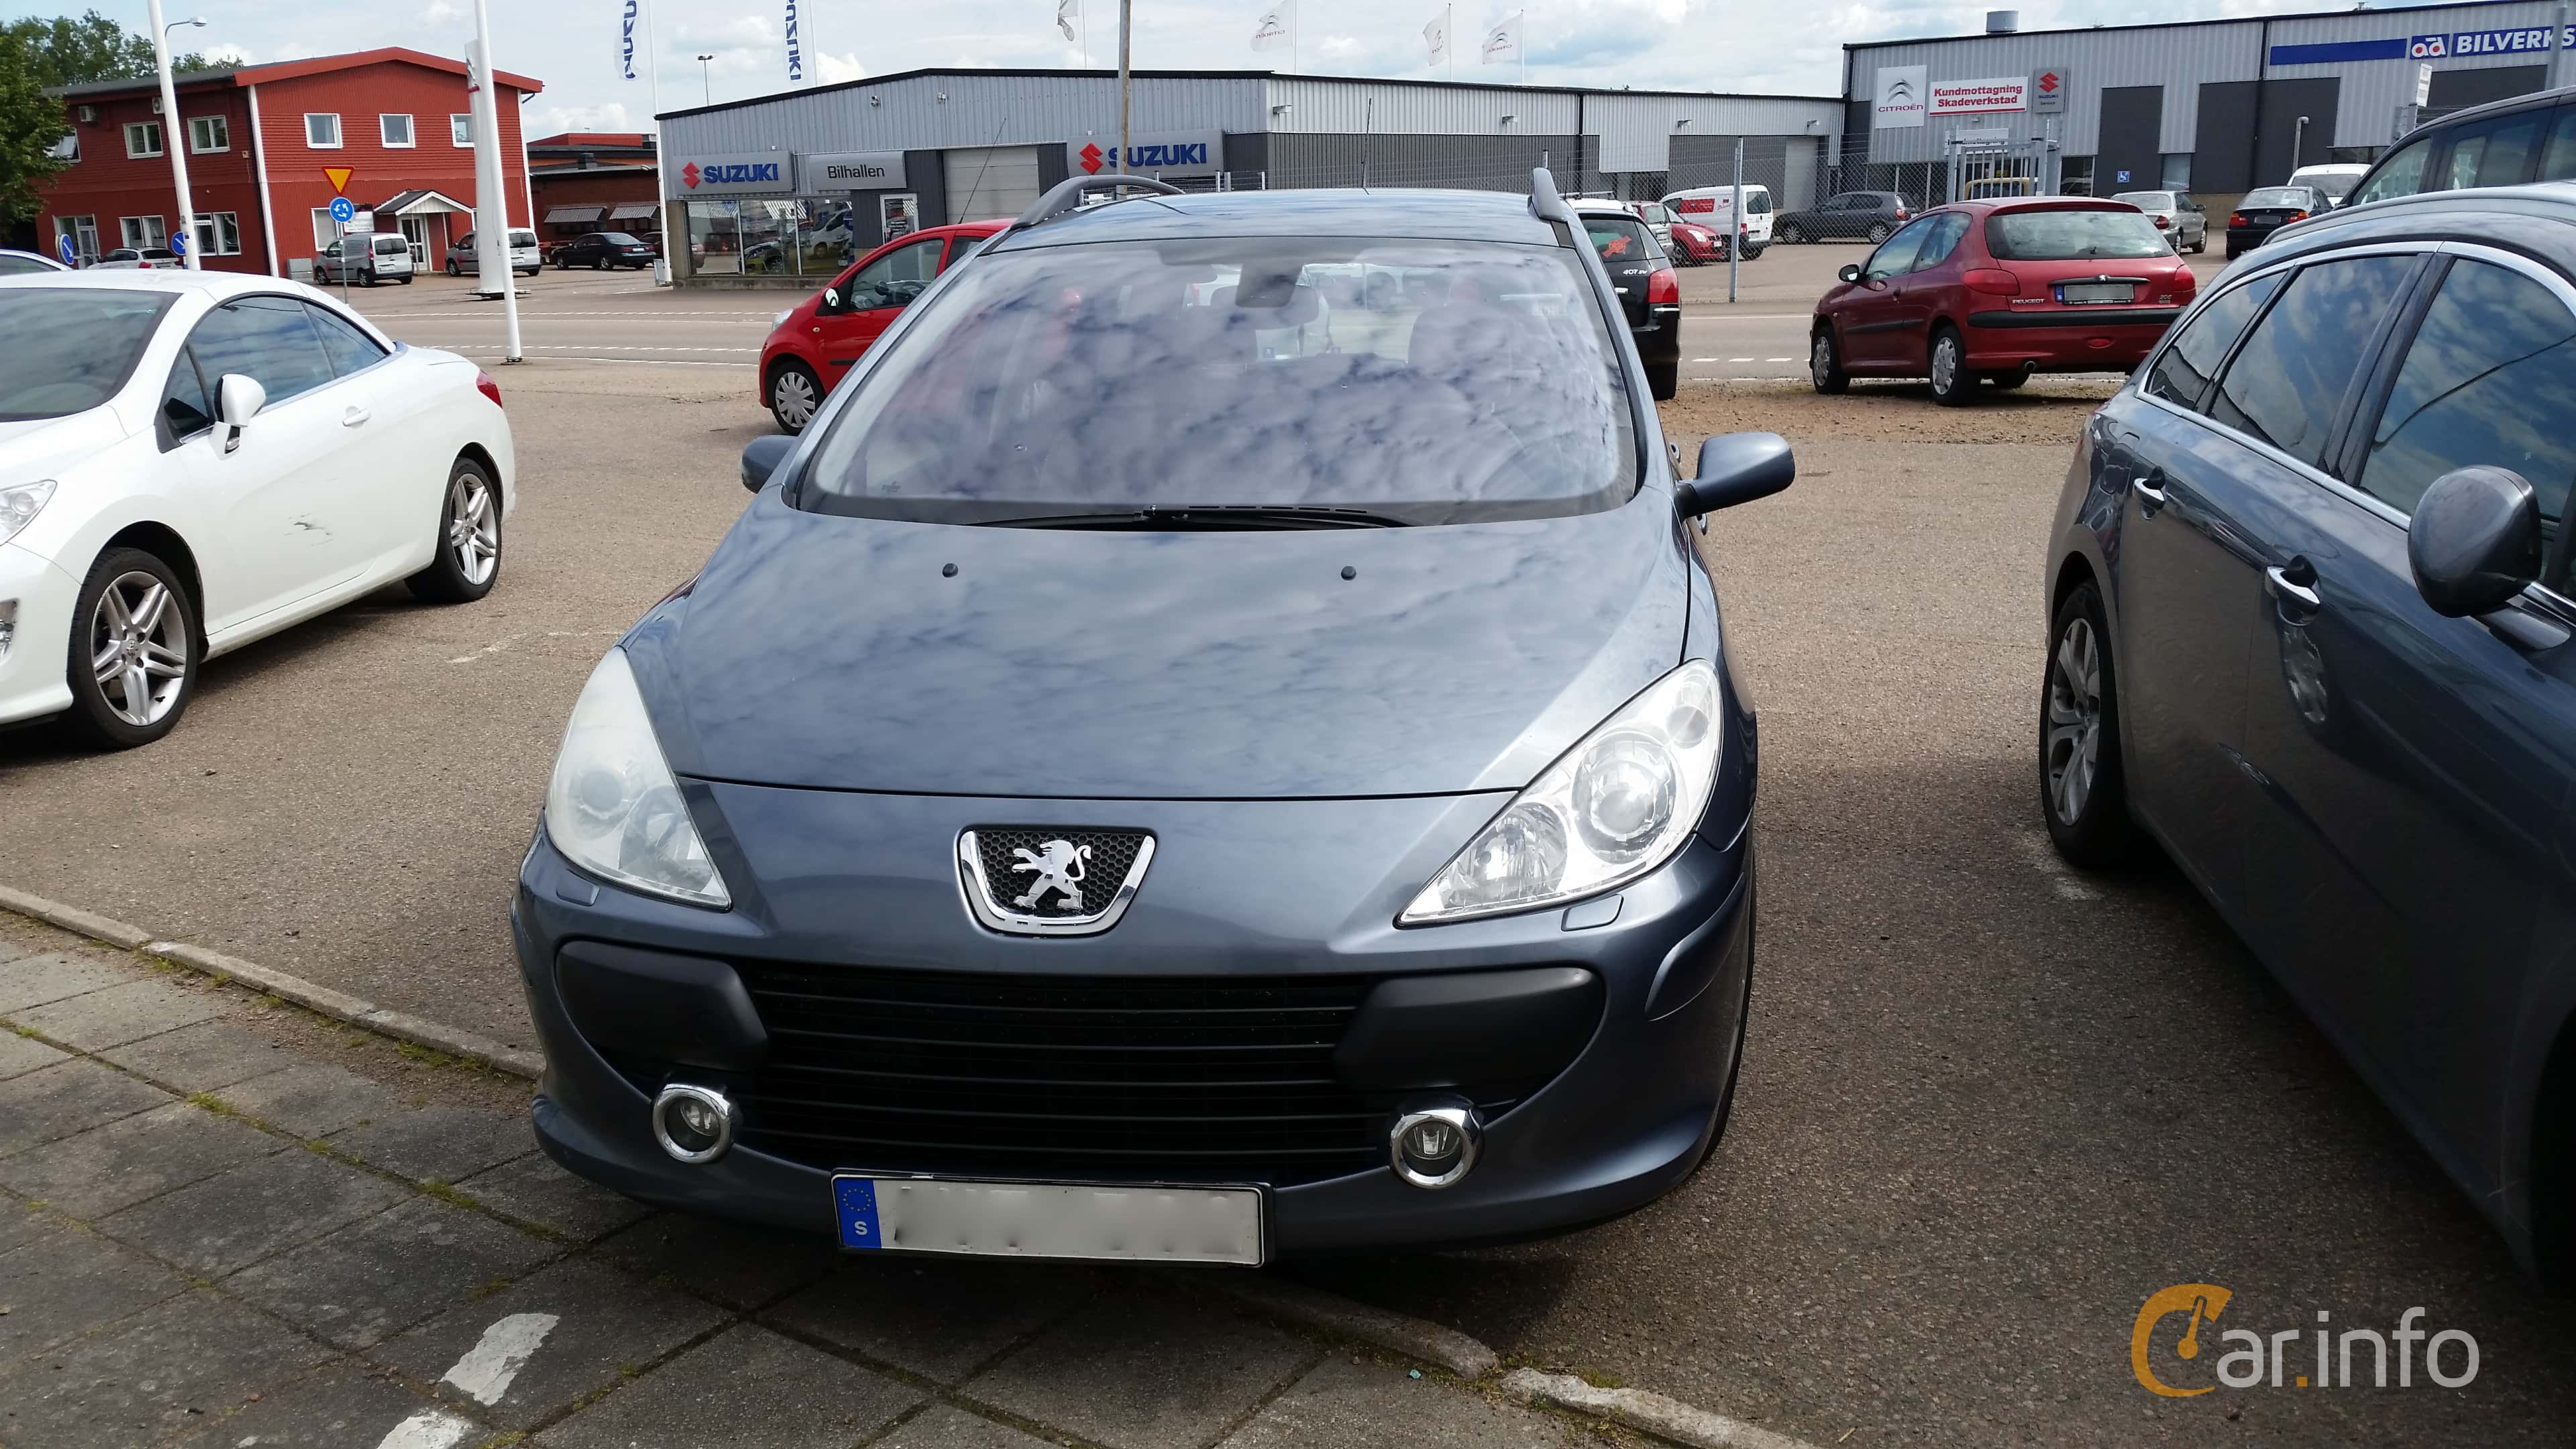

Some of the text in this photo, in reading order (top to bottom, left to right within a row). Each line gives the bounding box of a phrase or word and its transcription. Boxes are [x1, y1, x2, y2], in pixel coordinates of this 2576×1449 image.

[1934, 84, 2023, 97] Kundmottagning
[1937, 95, 2018, 107] Skadeverkstad
[704, 163, 779, 183] SUZUKI
[827, 164, 885, 178] Bilhallen
[854, 1221, 868, 1236] S
